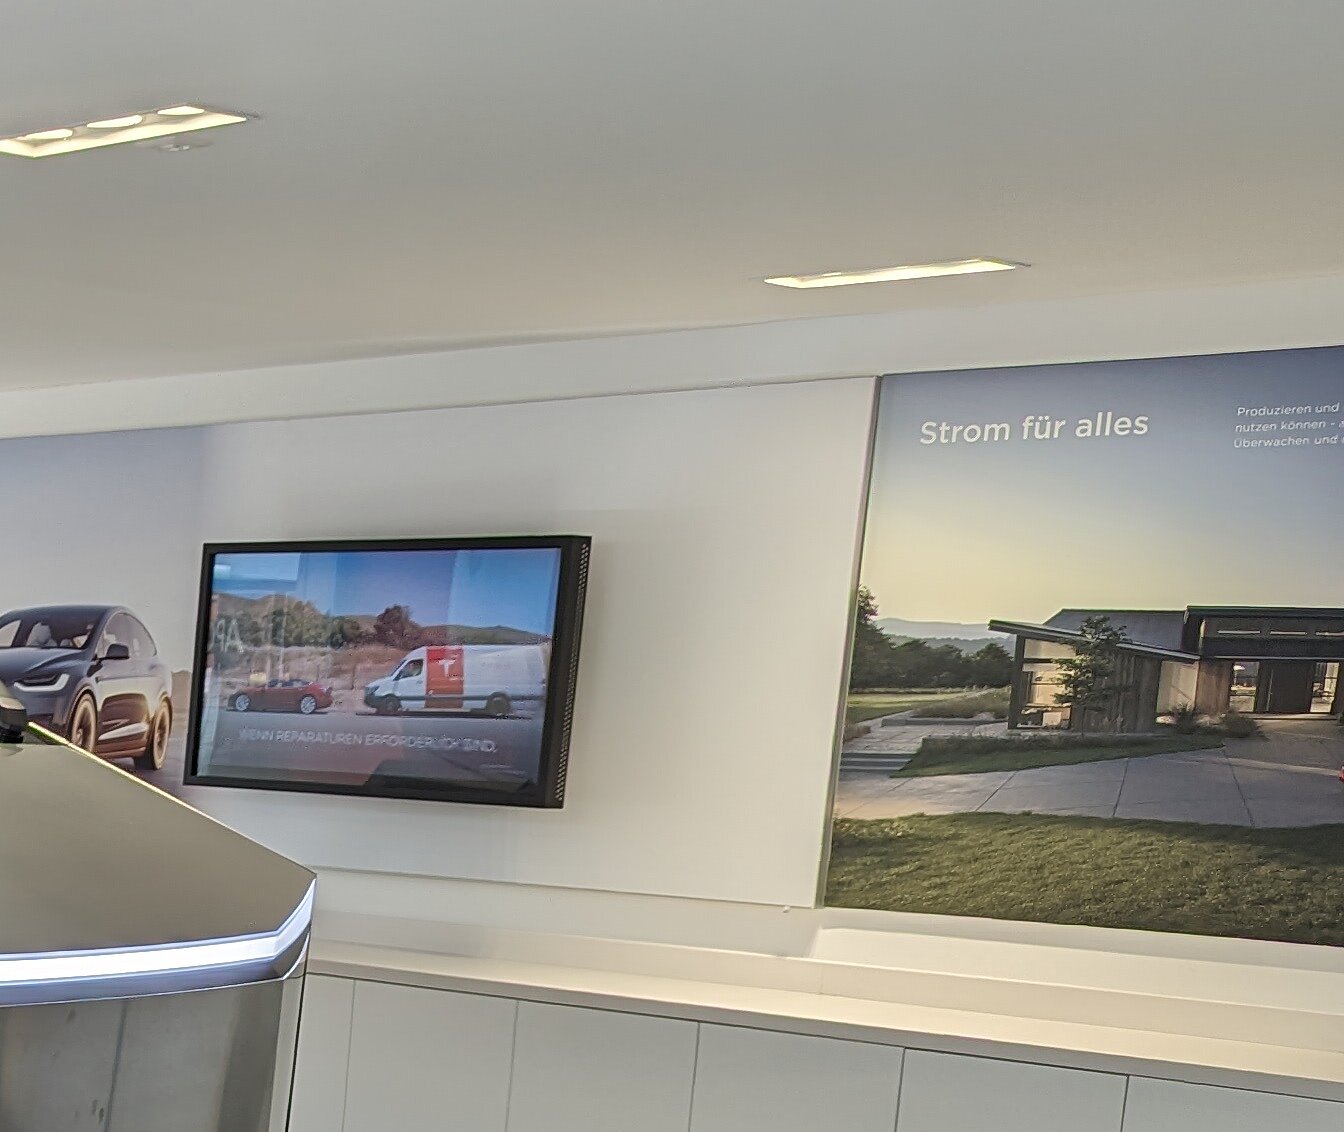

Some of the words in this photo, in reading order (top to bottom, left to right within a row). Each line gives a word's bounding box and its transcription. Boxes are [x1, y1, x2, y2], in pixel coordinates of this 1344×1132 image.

[1237, 406, 1312, 417] Produzieren
[1315, 402, 1340, 413] und
[920, 420, 1010, 445] Strom
[1023, 415, 1066, 440] für
[1075, 411, 1150, 438] alles
[1235, 422, 1277, 433] nutzen
[1280, 420, 1326, 431] können
[1314, 434, 1339, 445] und
